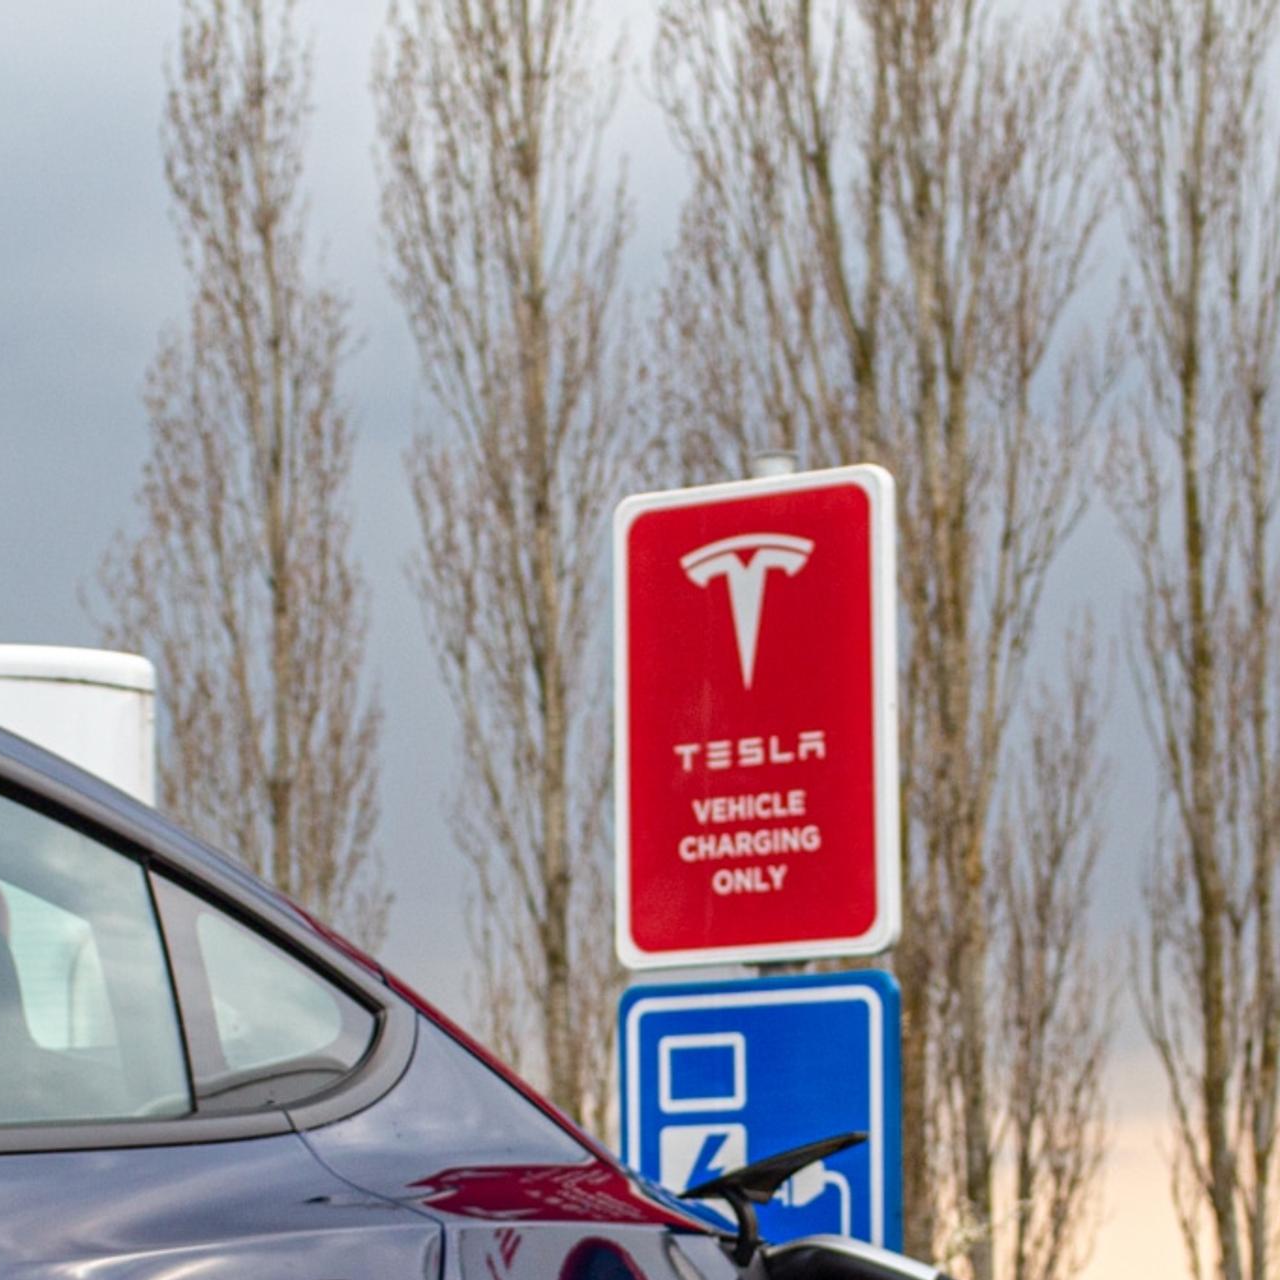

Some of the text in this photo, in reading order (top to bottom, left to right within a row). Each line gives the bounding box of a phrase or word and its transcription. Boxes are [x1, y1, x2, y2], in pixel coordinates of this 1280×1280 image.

[673, 730, 826, 772] TESLA
[692, 790, 806, 824] VEHICLE
[679, 825, 821, 862] CHARGING
[712, 864, 788, 896] ONLY
